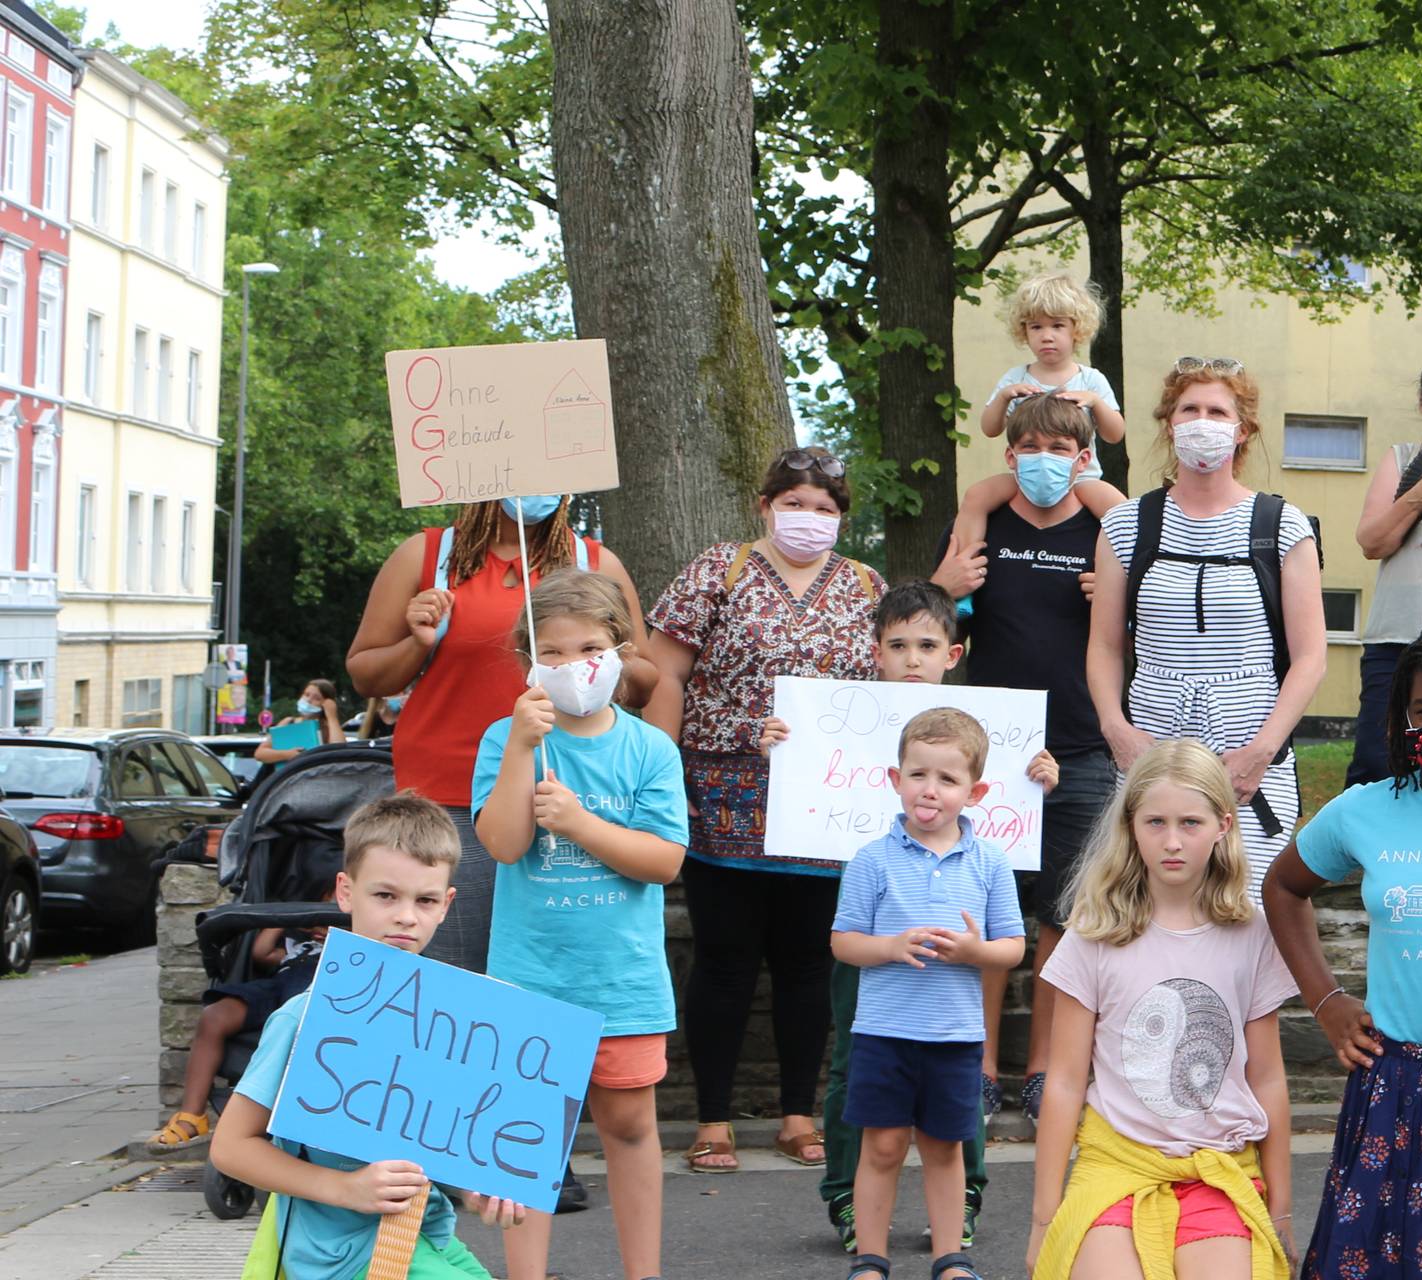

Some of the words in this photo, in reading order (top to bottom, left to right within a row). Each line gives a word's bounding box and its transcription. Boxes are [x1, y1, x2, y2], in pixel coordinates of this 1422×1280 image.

[406, 356, 500, 412] Ohne
[419, 455, 516, 504] Schlecht
[998, 547, 1035, 560] Dushi
[1037, 550, 1087, 565] Curaçao
[817, 686, 902, 736] Die
[576, 793, 633, 811] SCHUL
[546, 891, 627, 907] AACHEN
[366, 968, 559, 1086] Anna
